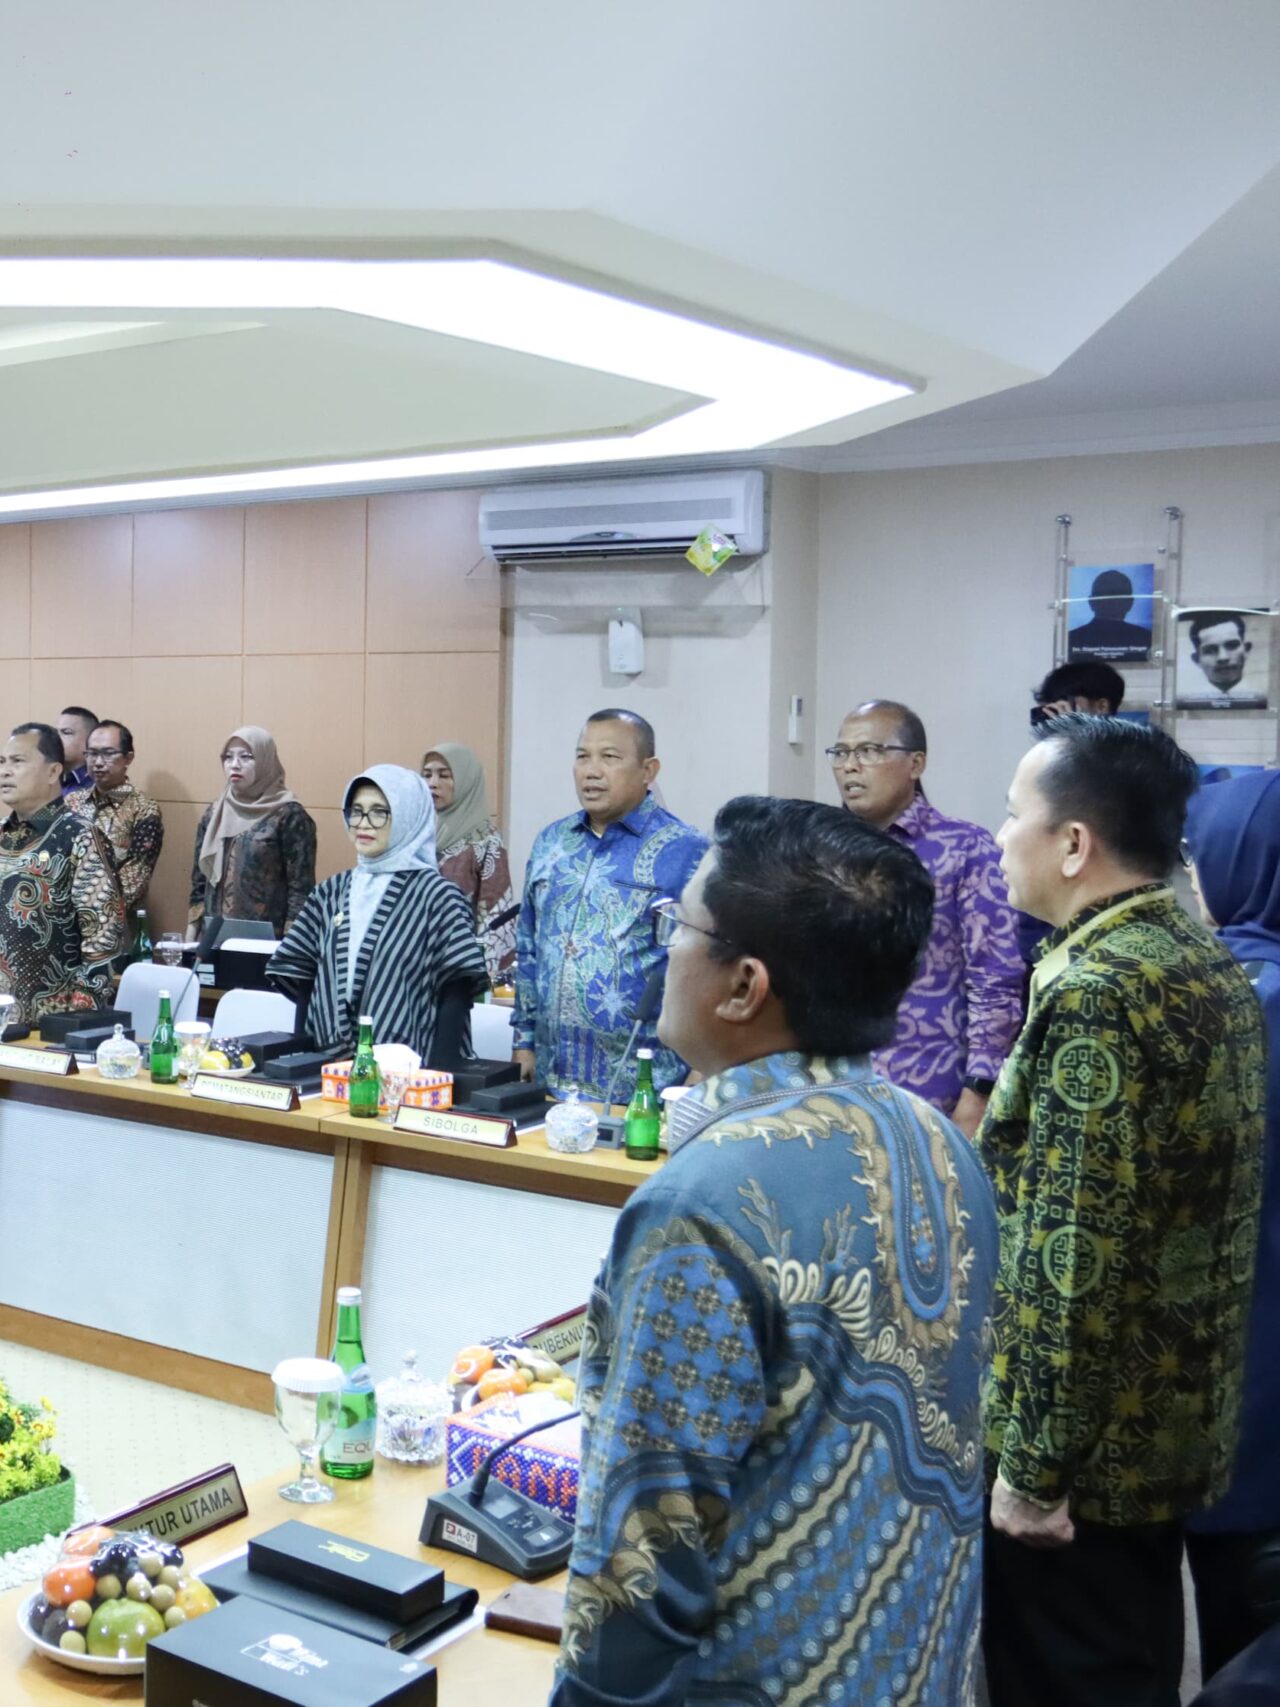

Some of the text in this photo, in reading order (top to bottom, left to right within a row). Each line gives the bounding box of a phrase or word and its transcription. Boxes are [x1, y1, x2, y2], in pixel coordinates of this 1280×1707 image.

[423, 1116, 478, 1135] SIBOLGA
[532, 1322, 586, 1354] UBERNU
[128, 1487, 233, 1536] TUR UTAMA
[457, 1528, 476, 1545] A-07
